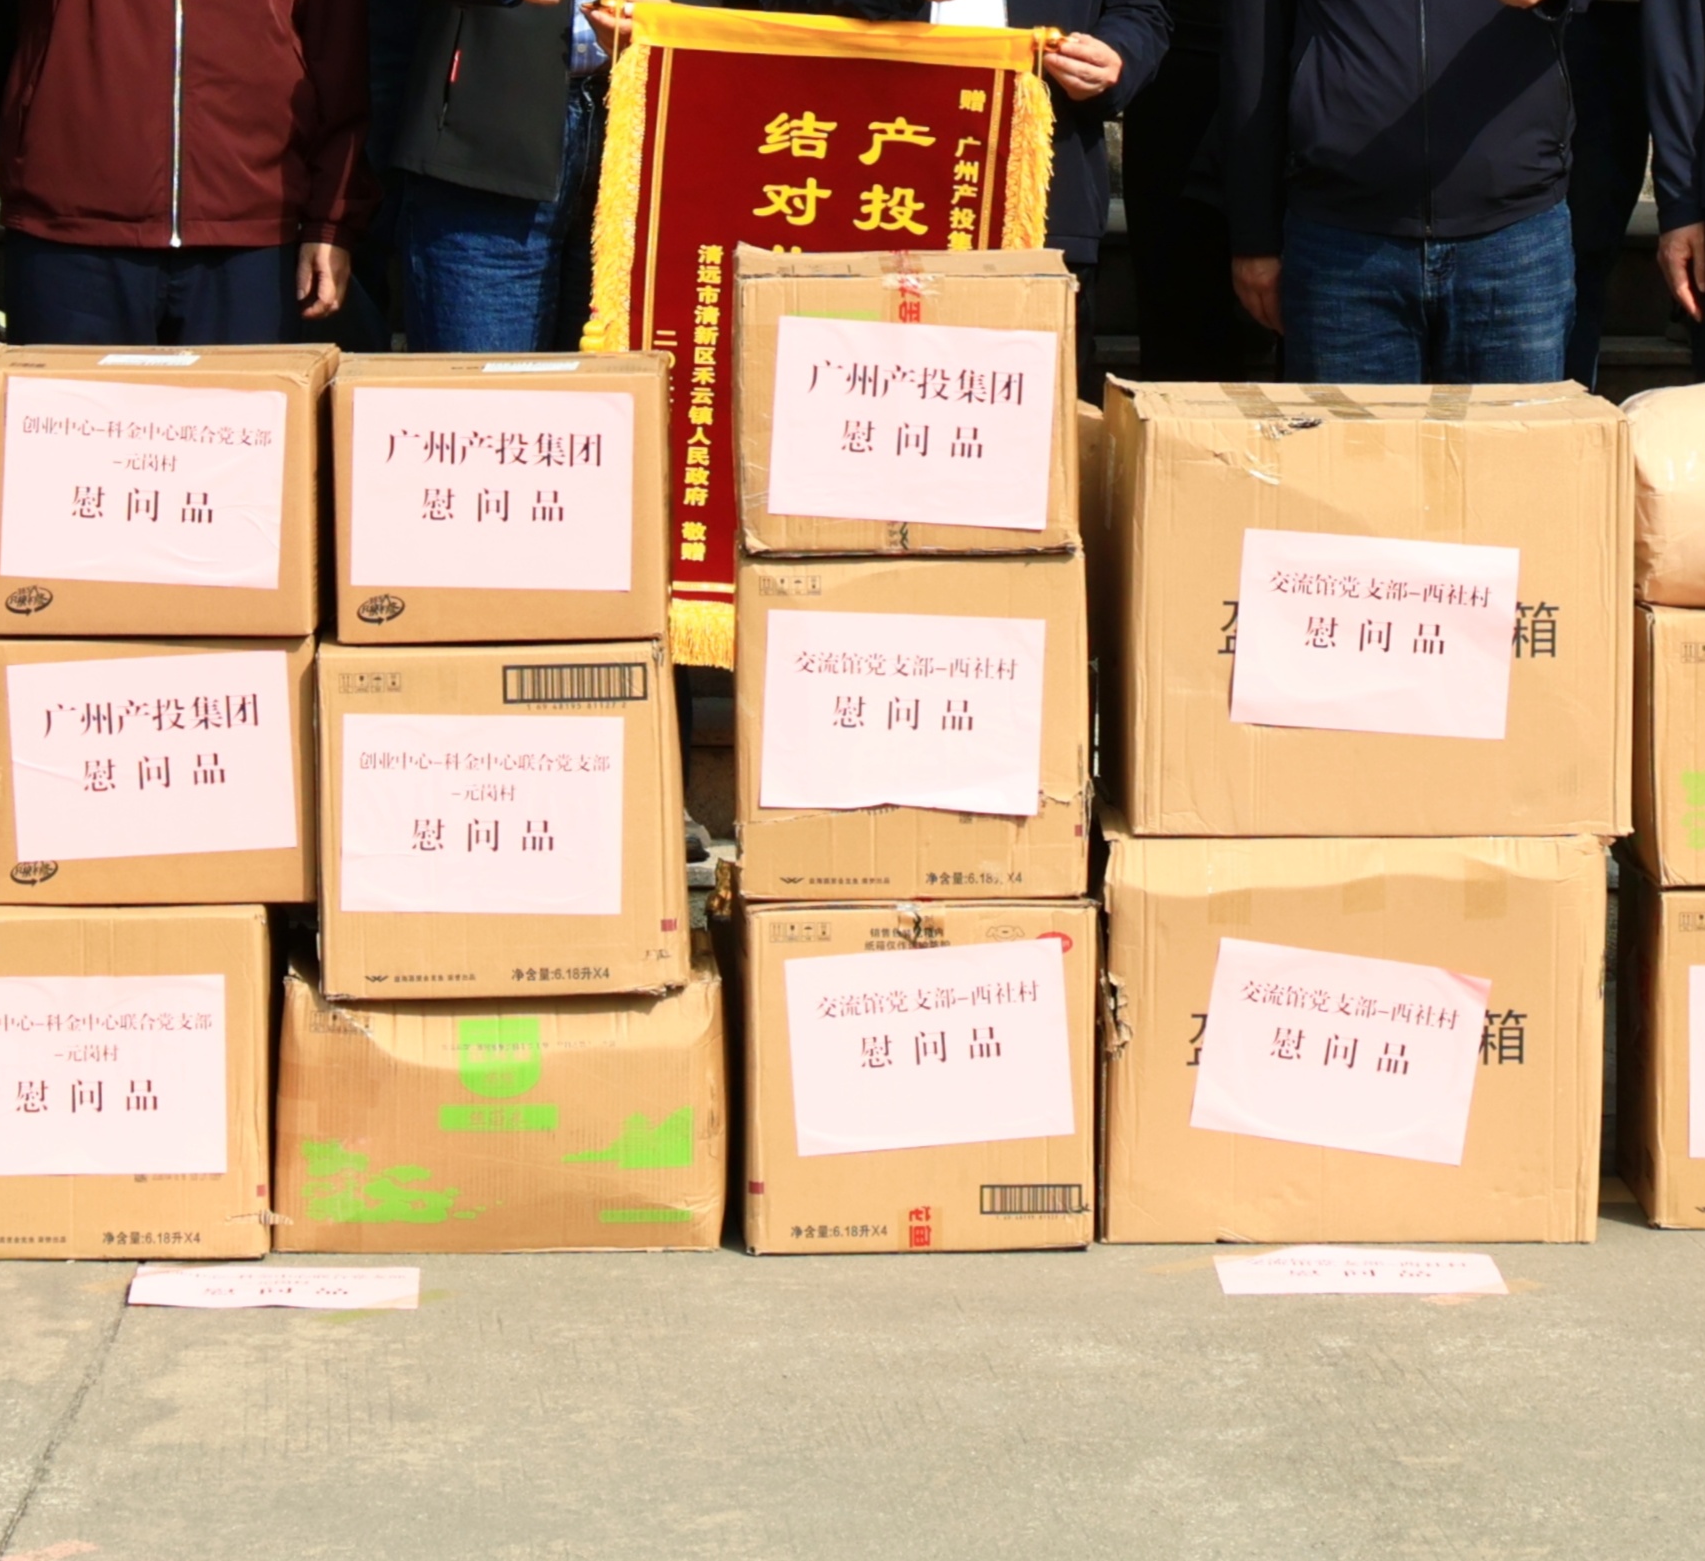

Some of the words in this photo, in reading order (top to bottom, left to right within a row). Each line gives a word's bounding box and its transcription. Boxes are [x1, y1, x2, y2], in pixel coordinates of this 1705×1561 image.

[752, 111, 838, 254] 结对
[853, 116, 937, 236] 产投
[683, 244, 725, 507] 清远市清新区禾云镇人民政府
[808, 359, 1025, 407] 广州产投集团
[22, 414, 273, 448] 创业中心-科金中心联合党支部
[386, 429, 602, 468] 广州产投集团
[841, 419, 984, 460] 慰问品
[112, 452, 178, 473] -元岗村
[71, 485, 214, 525] 慰问品
[421, 487, 565, 523] 慰问品
[681, 522, 707, 562] 敬赠
[1269, 570, 1492, 609] 交流馆党支部-西社村
[1304, 615, 1445, 656] 慰问品
[794, 650, 1019, 681] 交流馆党支部-西社村
[44, 692, 259, 738] 广州产投集团
[832, 695, 974, 732] 慰问品
[83, 752, 226, 793] 慰问品
[358, 751, 611, 774] 创业中心-科金中心联合党支部
[451, 783, 517, 803] -元岗村
[411, 818, 555, 853] 慰问品
[510, 965, 611, 982] 净含量:6.18升X4
[816, 979, 1040, 1019] 交流馆党支部-西社村
[1241, 979, 1461, 1037] 交流馆党支部-西社村
[53, 1043, 120, 1063] -元岗村
[861, 1025, 1002, 1069] 慰问品
[1269, 1026, 1410, 1076] 慰问品
[15, 1078, 159, 1114] 慰问品
[101, 1230, 202, 1246] 净含量:6.18升X4
[790, 1223, 889, 1240] 净含量:6.18升X4
